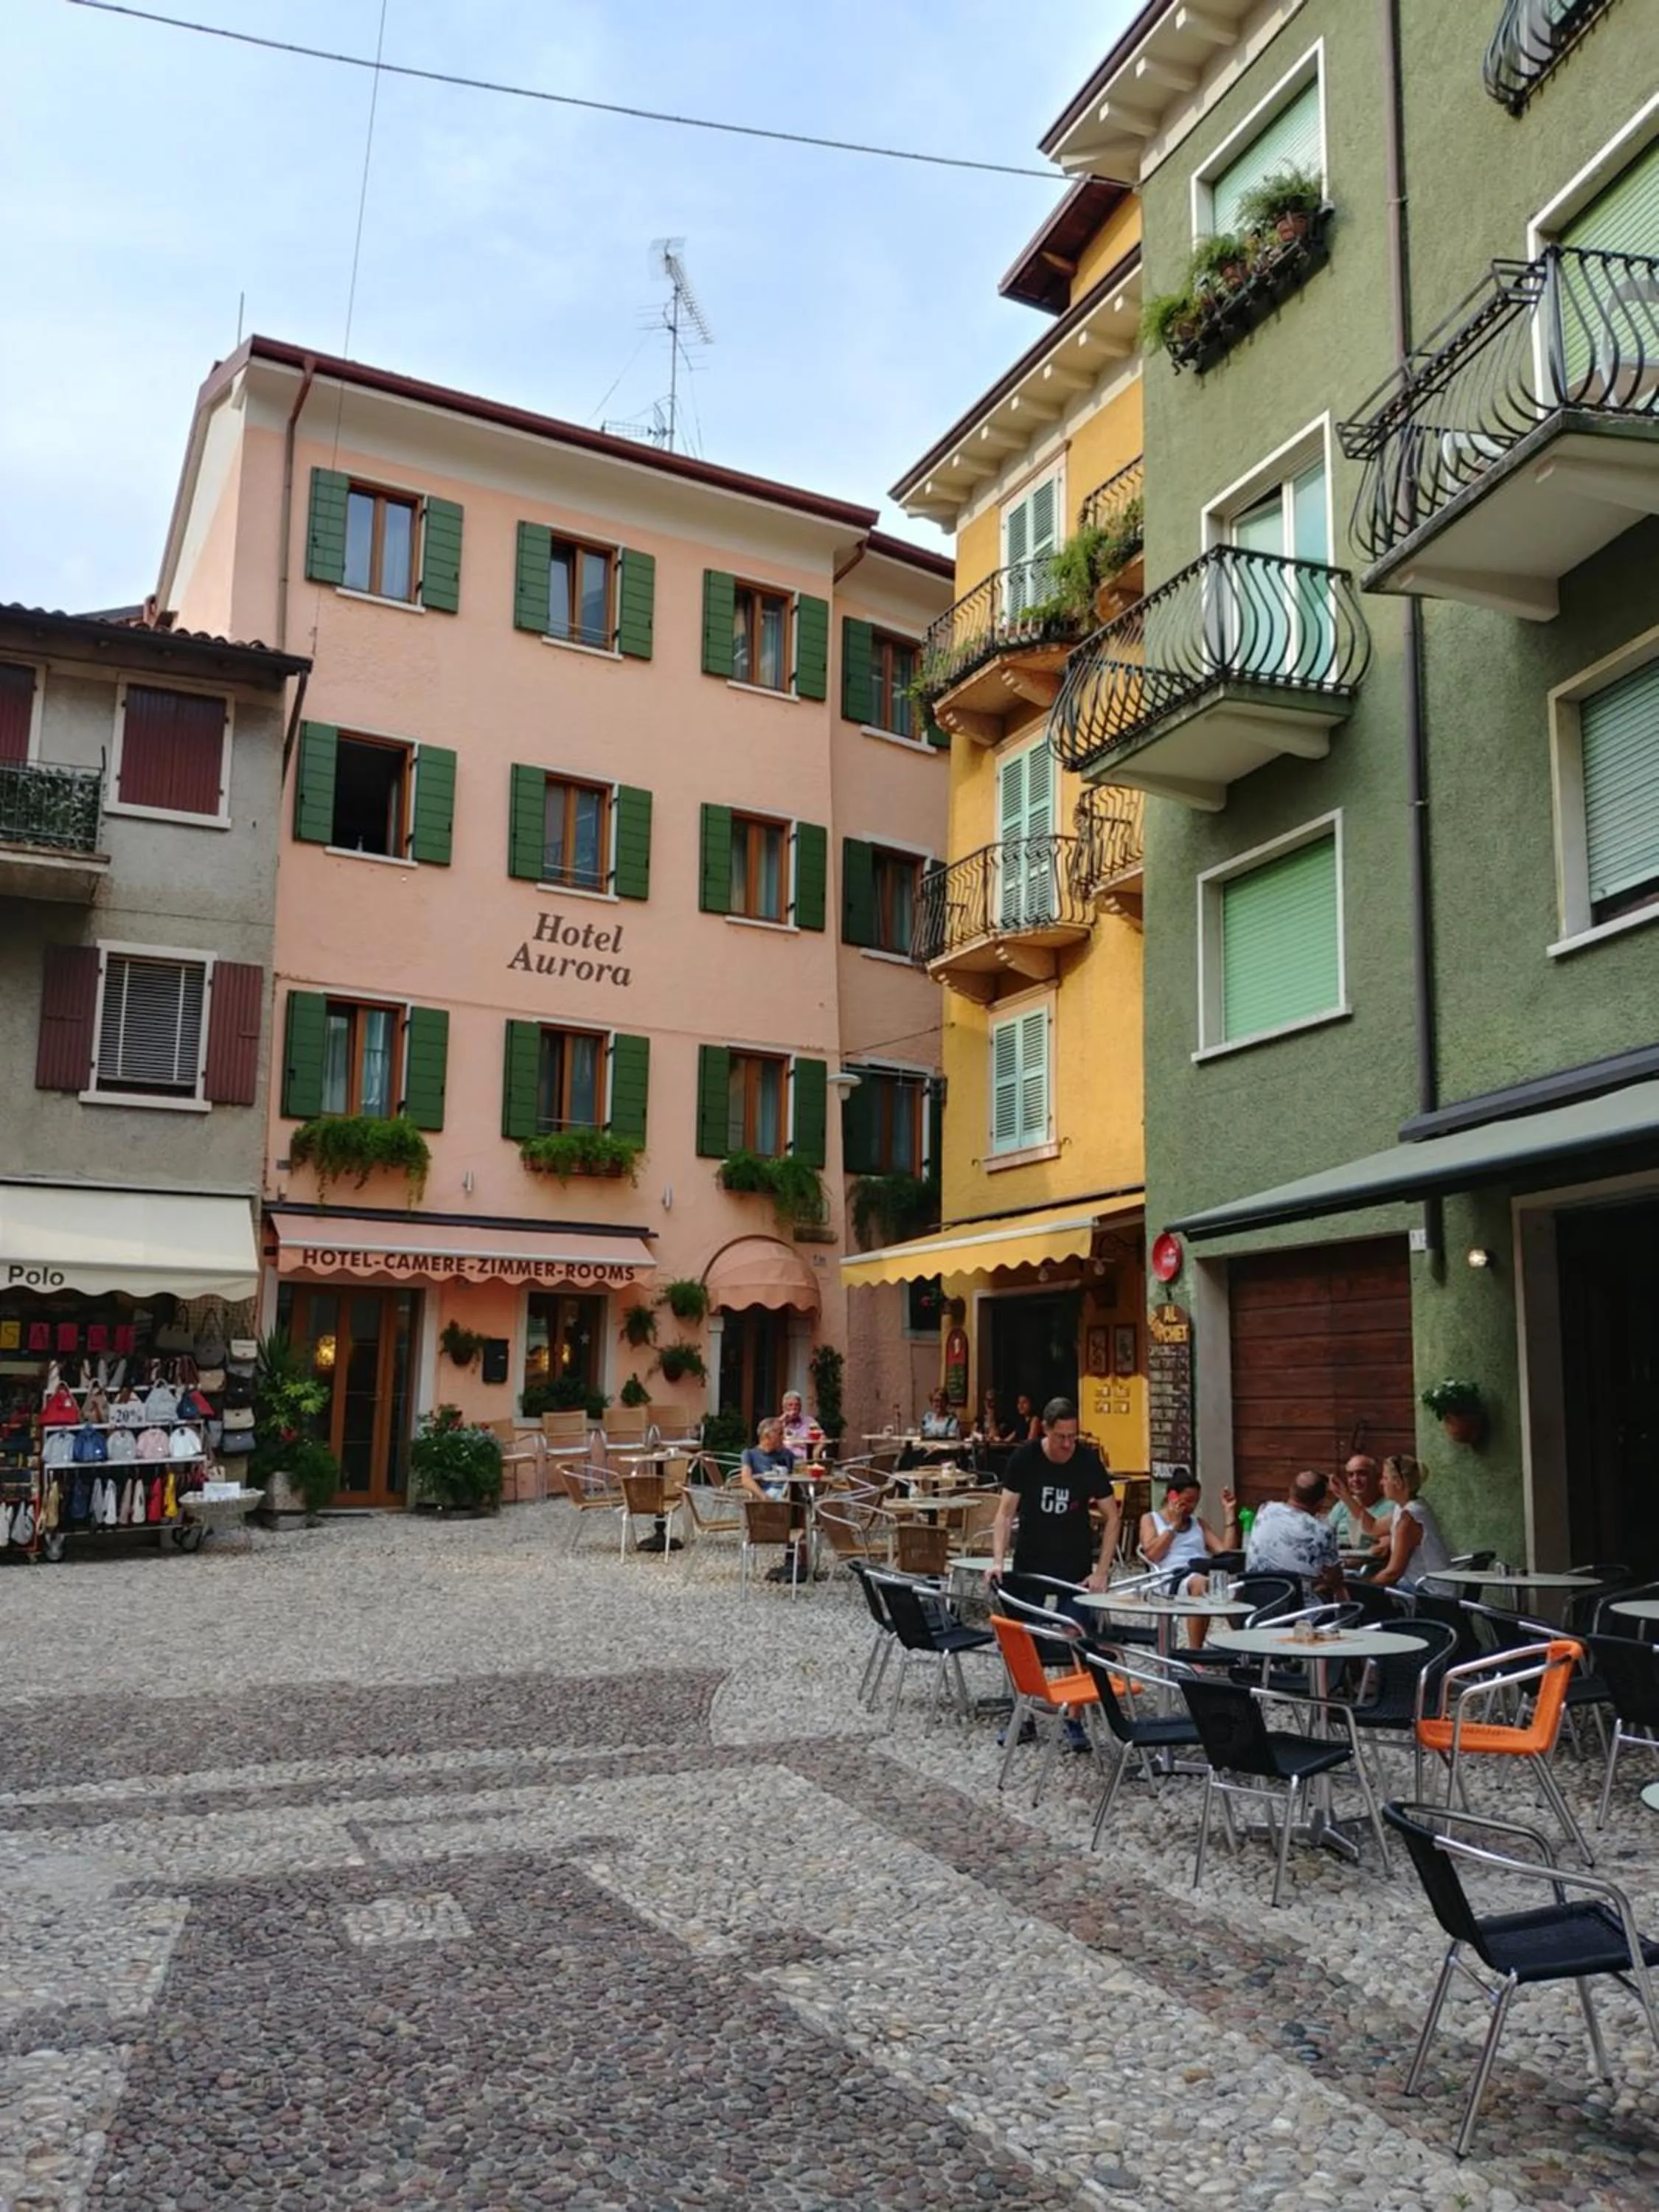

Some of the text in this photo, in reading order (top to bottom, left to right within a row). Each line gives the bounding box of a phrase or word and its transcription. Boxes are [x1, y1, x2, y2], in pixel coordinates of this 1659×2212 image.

[532, 911, 625, 954] Hotel
[507, 941, 632, 987] Aurora
[8, 1265, 65, 1286] Polo
